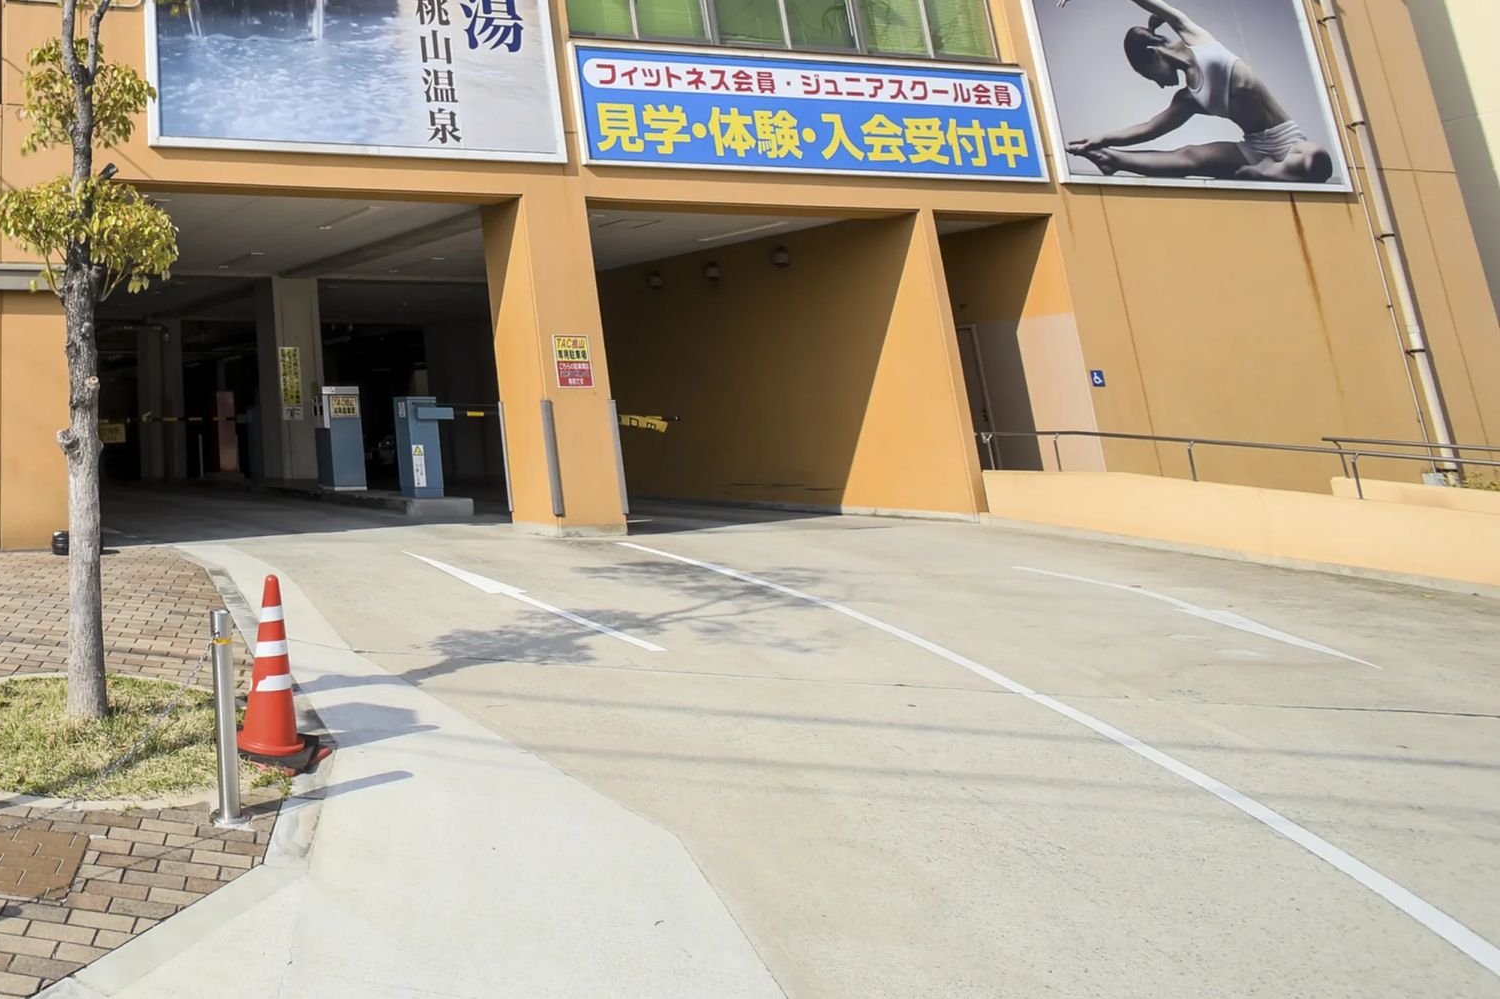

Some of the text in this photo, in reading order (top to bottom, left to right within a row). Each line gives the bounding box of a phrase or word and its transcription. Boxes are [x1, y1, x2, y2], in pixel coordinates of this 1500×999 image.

[597, 102, 1029, 169] 見学・体験・入会受付中
